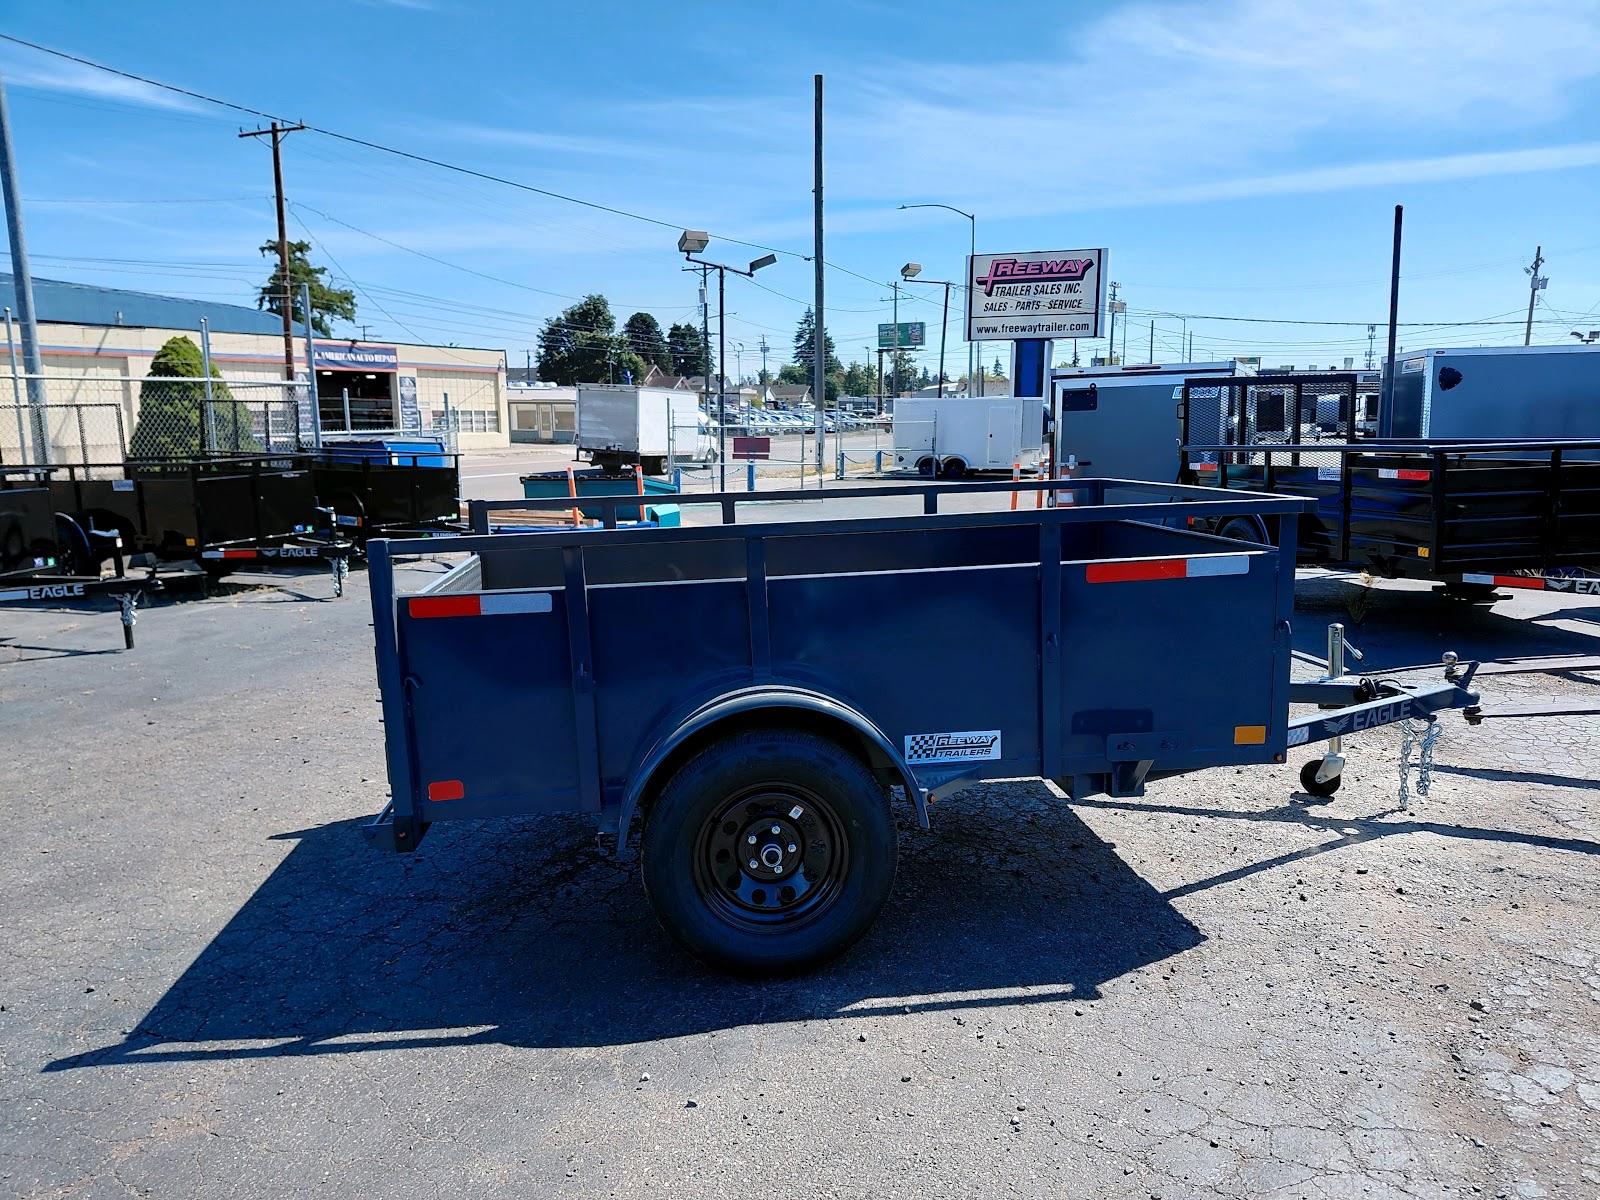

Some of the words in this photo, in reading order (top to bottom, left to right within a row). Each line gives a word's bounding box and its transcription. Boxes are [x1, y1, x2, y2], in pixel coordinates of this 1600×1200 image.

[976, 258, 1095, 297] FREEWAY
[995, 285, 1031, 297] TRAILER
[1033, 284, 1062, 296] SALES
[1063, 282, 1082, 294] INC.
[983, 301, 1008, 312] SALES
[1015, 300, 1041, 311] PARTS
[1047, 298, 1084, 309] SERVICE
[976, 321, 1090, 334] www.freewaytrailer.com
[355, 353, 374, 362] AUTO
[374, 354, 397, 363] REPAIR
[280, 547, 318, 557] EAGLE
[29, 583, 85, 599] EAGLE
[1353, 699, 1412, 731] EAGLE
[938, 748, 992, 758] TRAILERS
